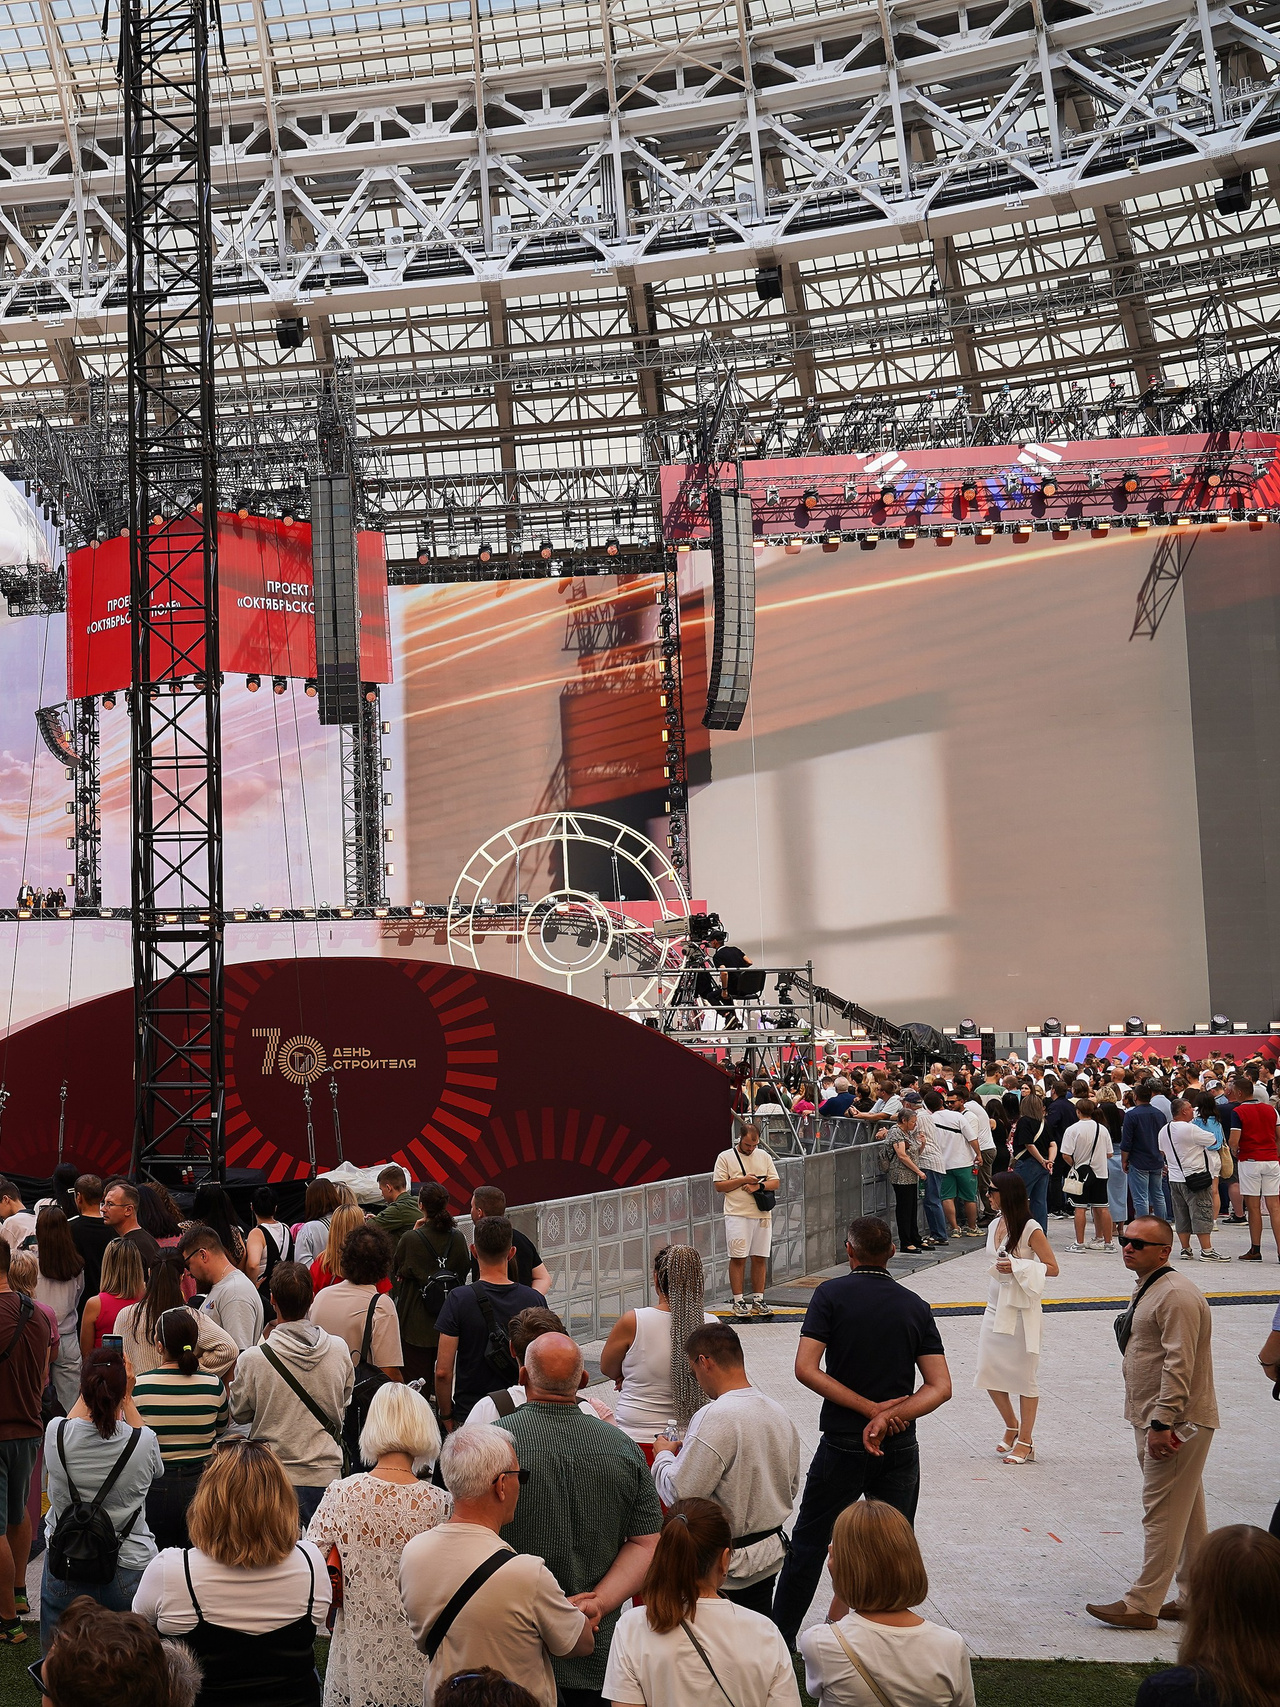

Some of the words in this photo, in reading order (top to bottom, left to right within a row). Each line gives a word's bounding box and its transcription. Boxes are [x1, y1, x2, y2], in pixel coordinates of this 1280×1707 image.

[267, 581, 308, 596] ПРОЕКТ
[237, 595, 315, 614] «ОКТЯБРЬСКО
[87, 612, 131, 634] «ОКТЯБРЬС
[332, 1047, 371, 1057] ДЕНЬ
[332, 1059, 416, 1070] СТРОИТЕЛЯ
